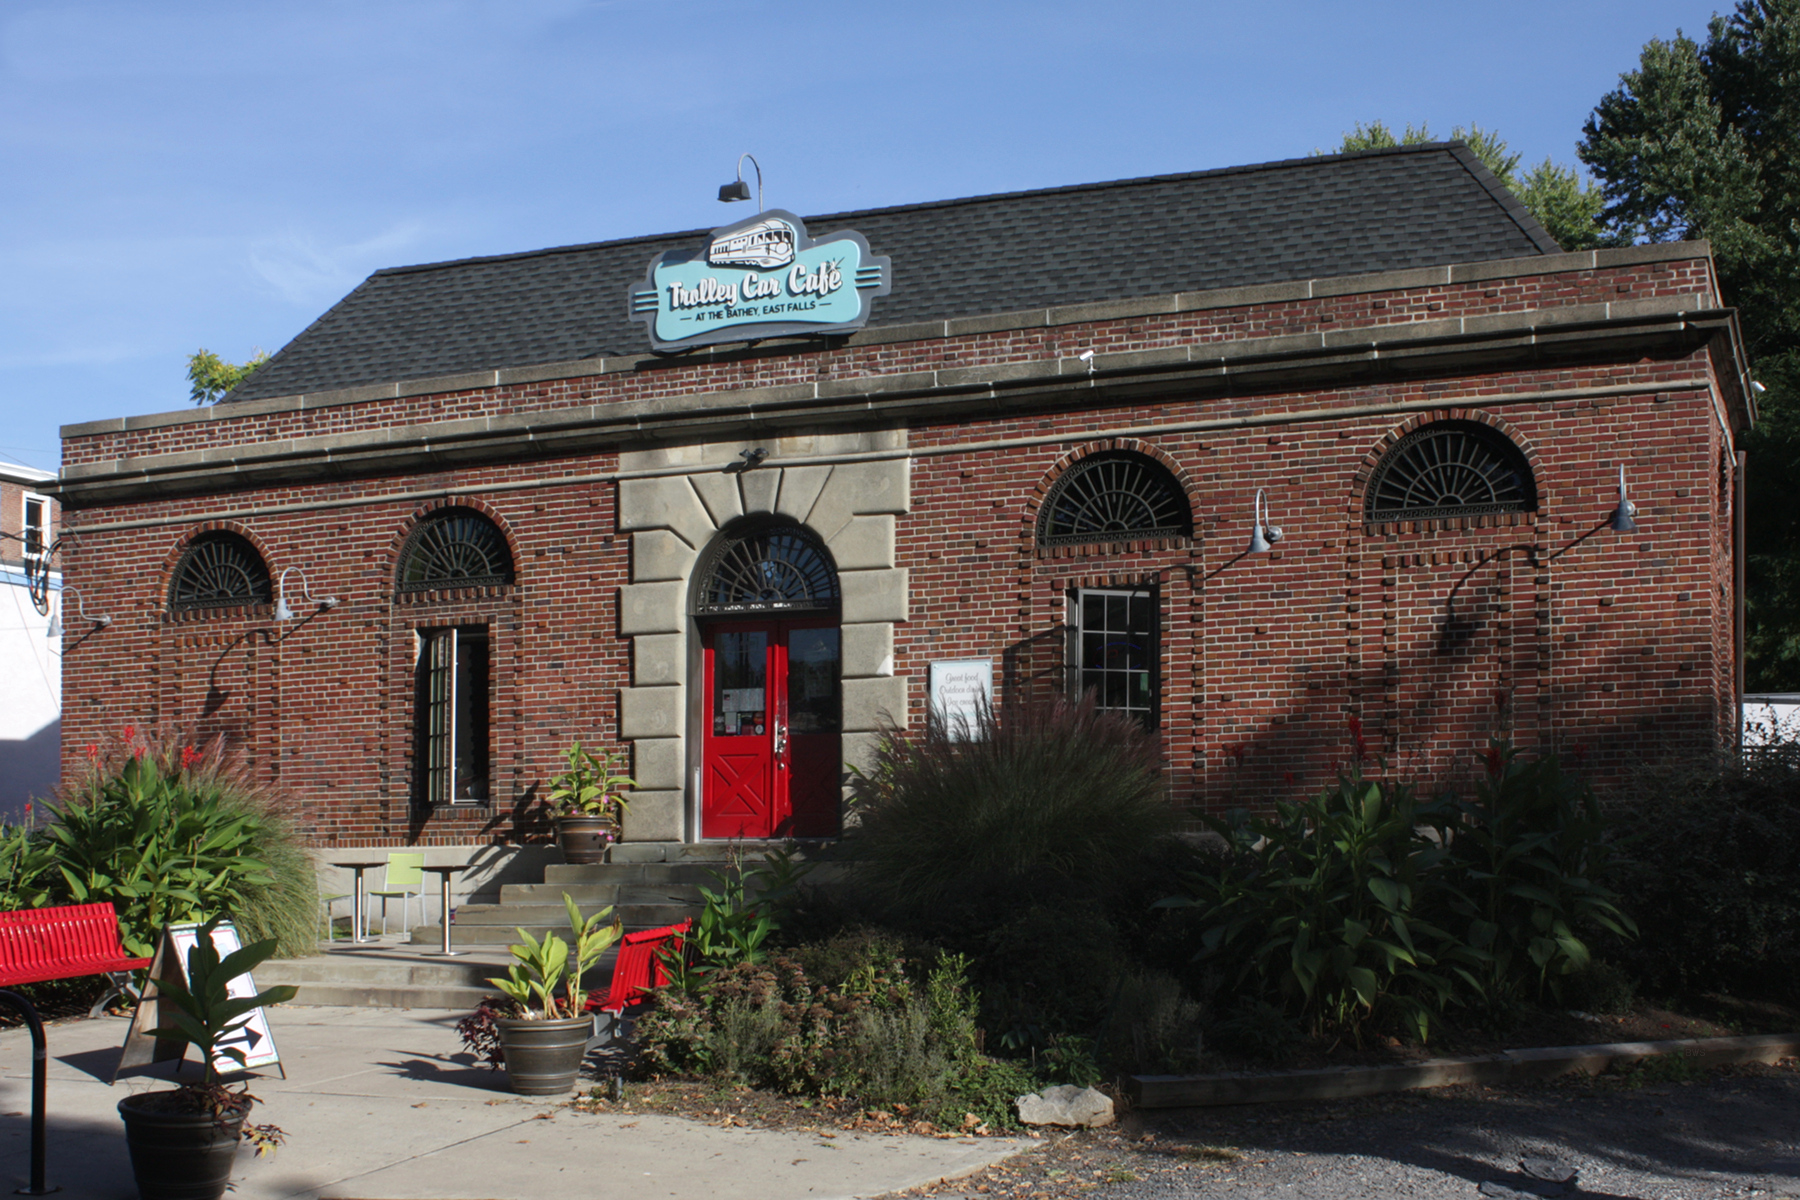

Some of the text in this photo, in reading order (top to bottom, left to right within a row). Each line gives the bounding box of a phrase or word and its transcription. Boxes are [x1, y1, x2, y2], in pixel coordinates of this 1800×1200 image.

[669, 277, 738, 307] Trolley
[742, 272, 781, 299] Car
[695, 301, 816, 321] AT THE BATHEY, EAST FALLS
